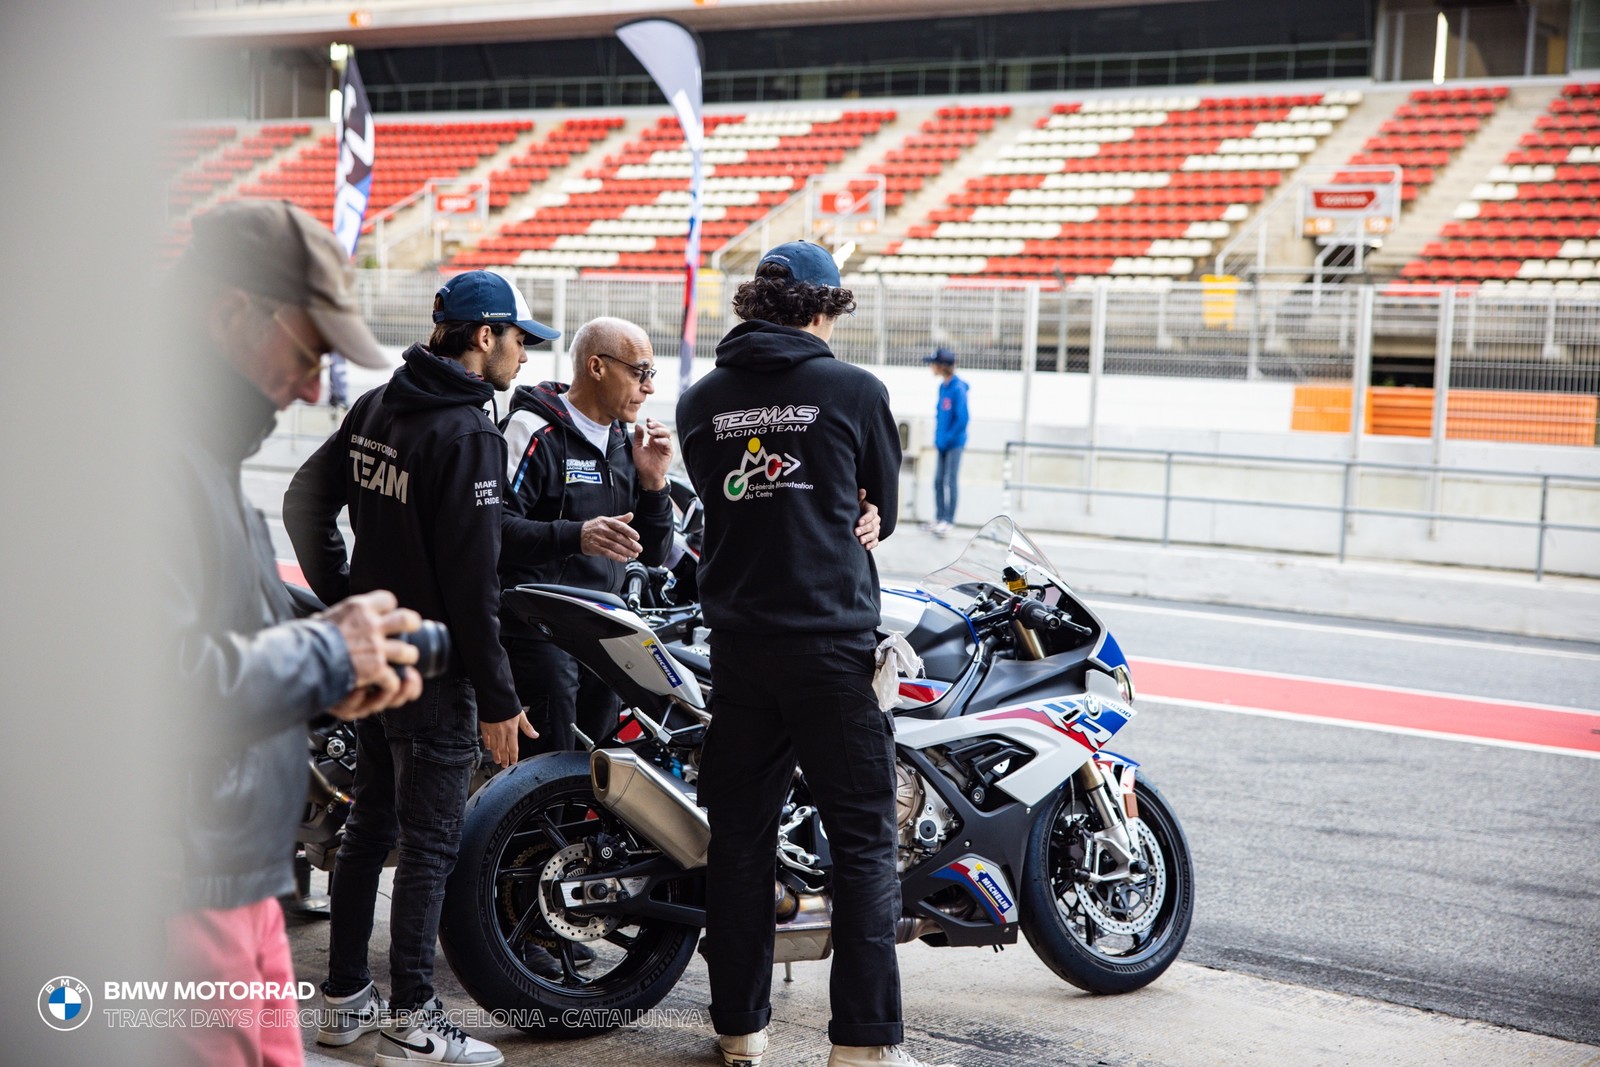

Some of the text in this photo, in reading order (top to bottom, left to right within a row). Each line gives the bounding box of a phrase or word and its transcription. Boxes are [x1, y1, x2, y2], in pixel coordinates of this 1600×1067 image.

[713, 405, 819, 433] TECMAS
[716, 425, 808, 441] RACING TEAM
[349, 449, 409, 505] TEAM
[474, 480, 497, 490] MAKE
[775, 480, 814, 490] Manutention
[475, 489, 493, 498] LIFE
[484, 496, 500, 505] RIDE
[744, 490, 773, 500] du Centre
[654, 653, 678, 683] MICHELIN
[981, 877, 1010, 910] MICHELIN
[644, 933, 684, 988] MICHELIN
